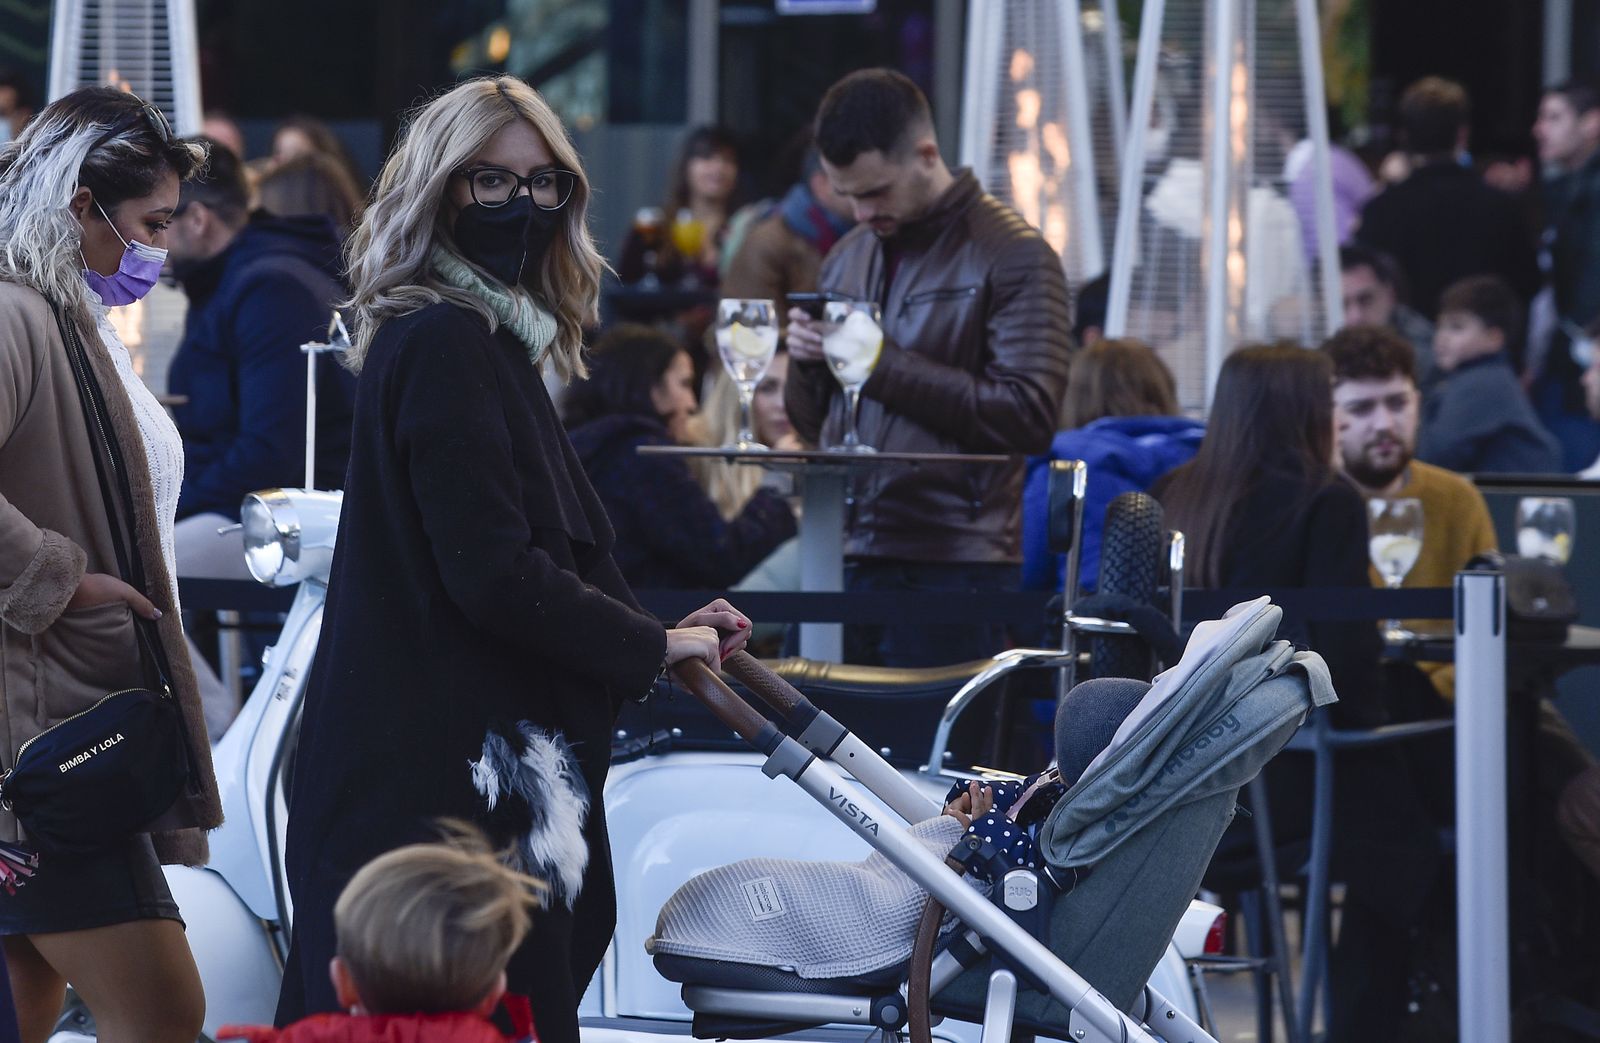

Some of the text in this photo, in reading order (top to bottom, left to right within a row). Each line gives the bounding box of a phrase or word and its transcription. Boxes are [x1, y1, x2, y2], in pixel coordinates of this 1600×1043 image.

[59, 733, 125, 773] BIMBA Y LOLA
[829, 785, 879, 837] VISTA
